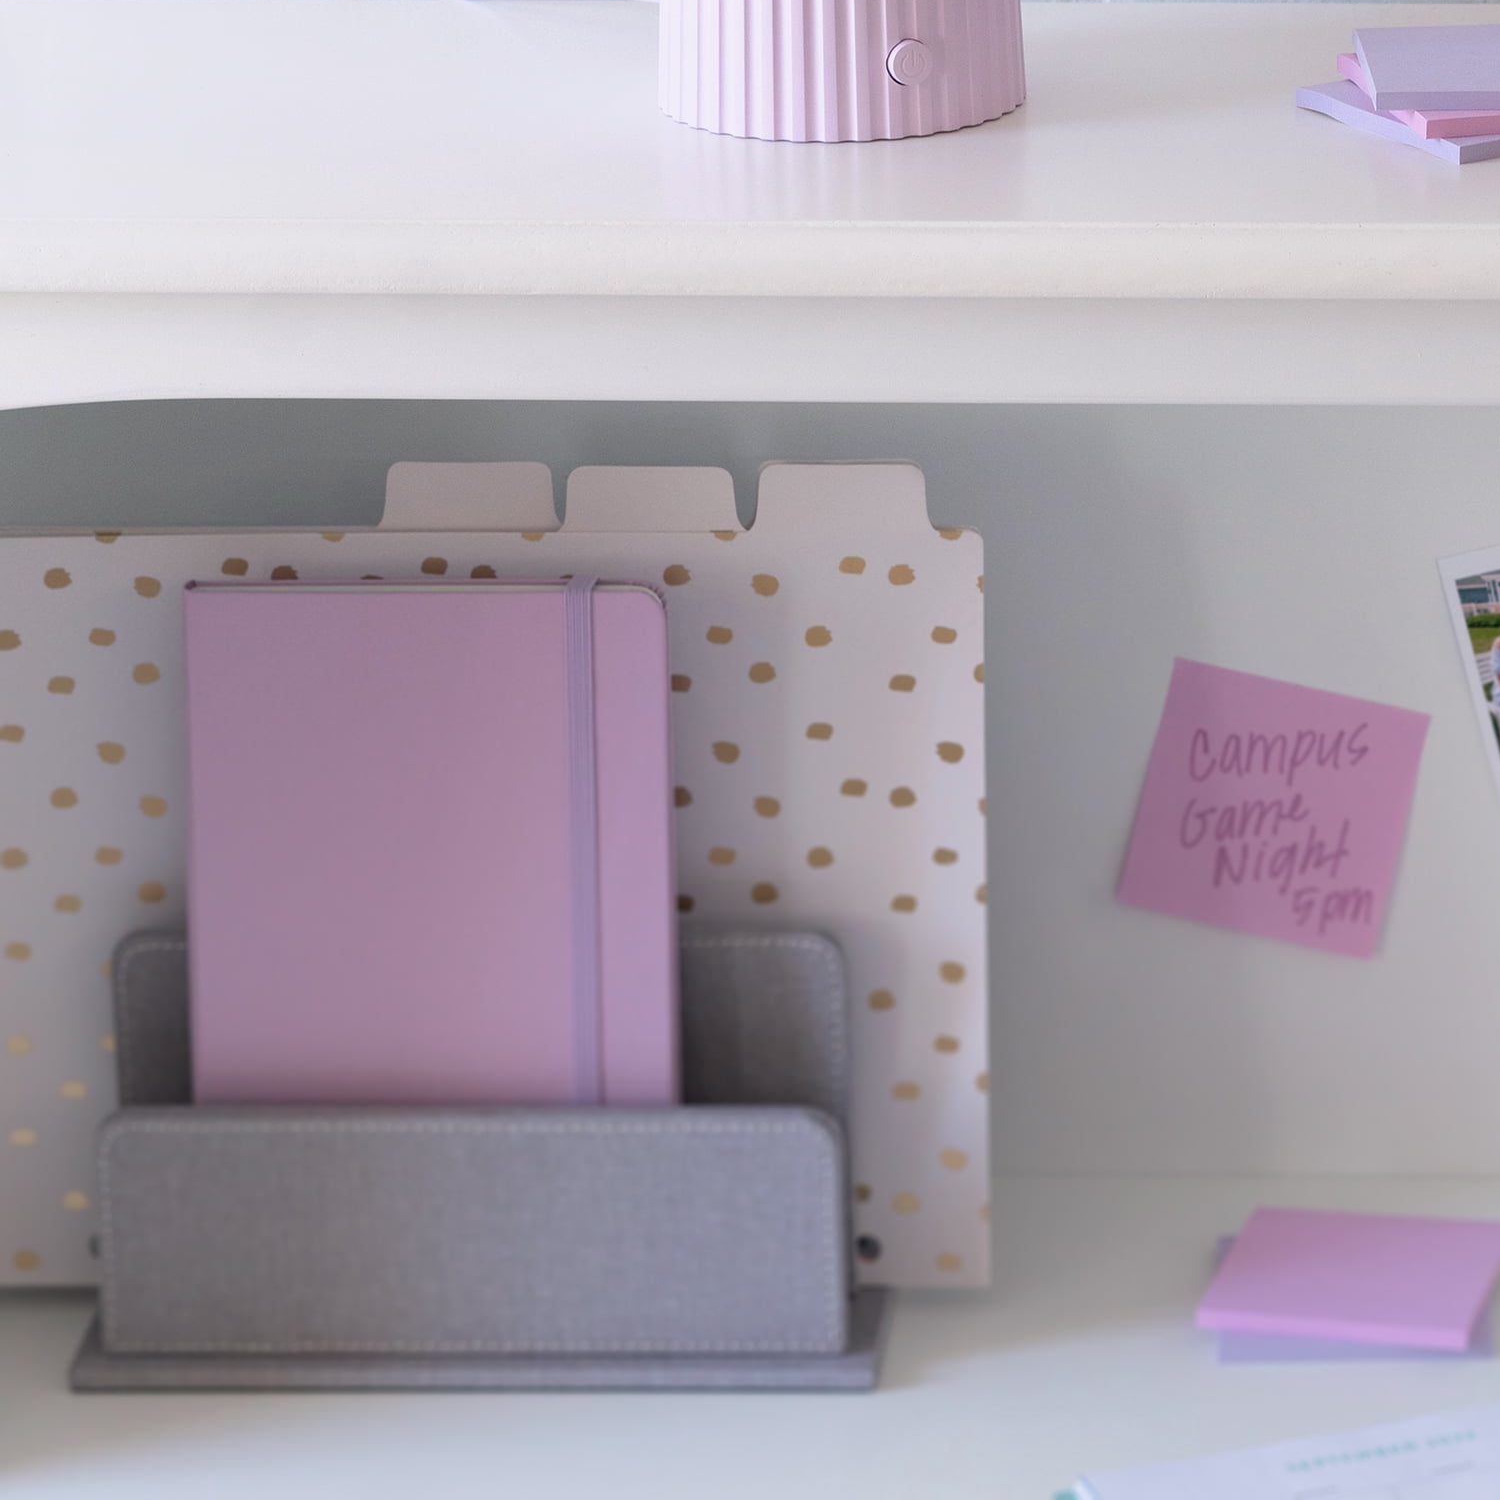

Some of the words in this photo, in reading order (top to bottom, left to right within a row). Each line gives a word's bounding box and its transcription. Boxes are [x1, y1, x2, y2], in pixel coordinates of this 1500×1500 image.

[1189, 721, 1370, 788] Campus
[1179, 793, 1311, 849] Game
[1212, 817, 1351, 897] Night
[1291, 887, 1375, 937] 5pm
